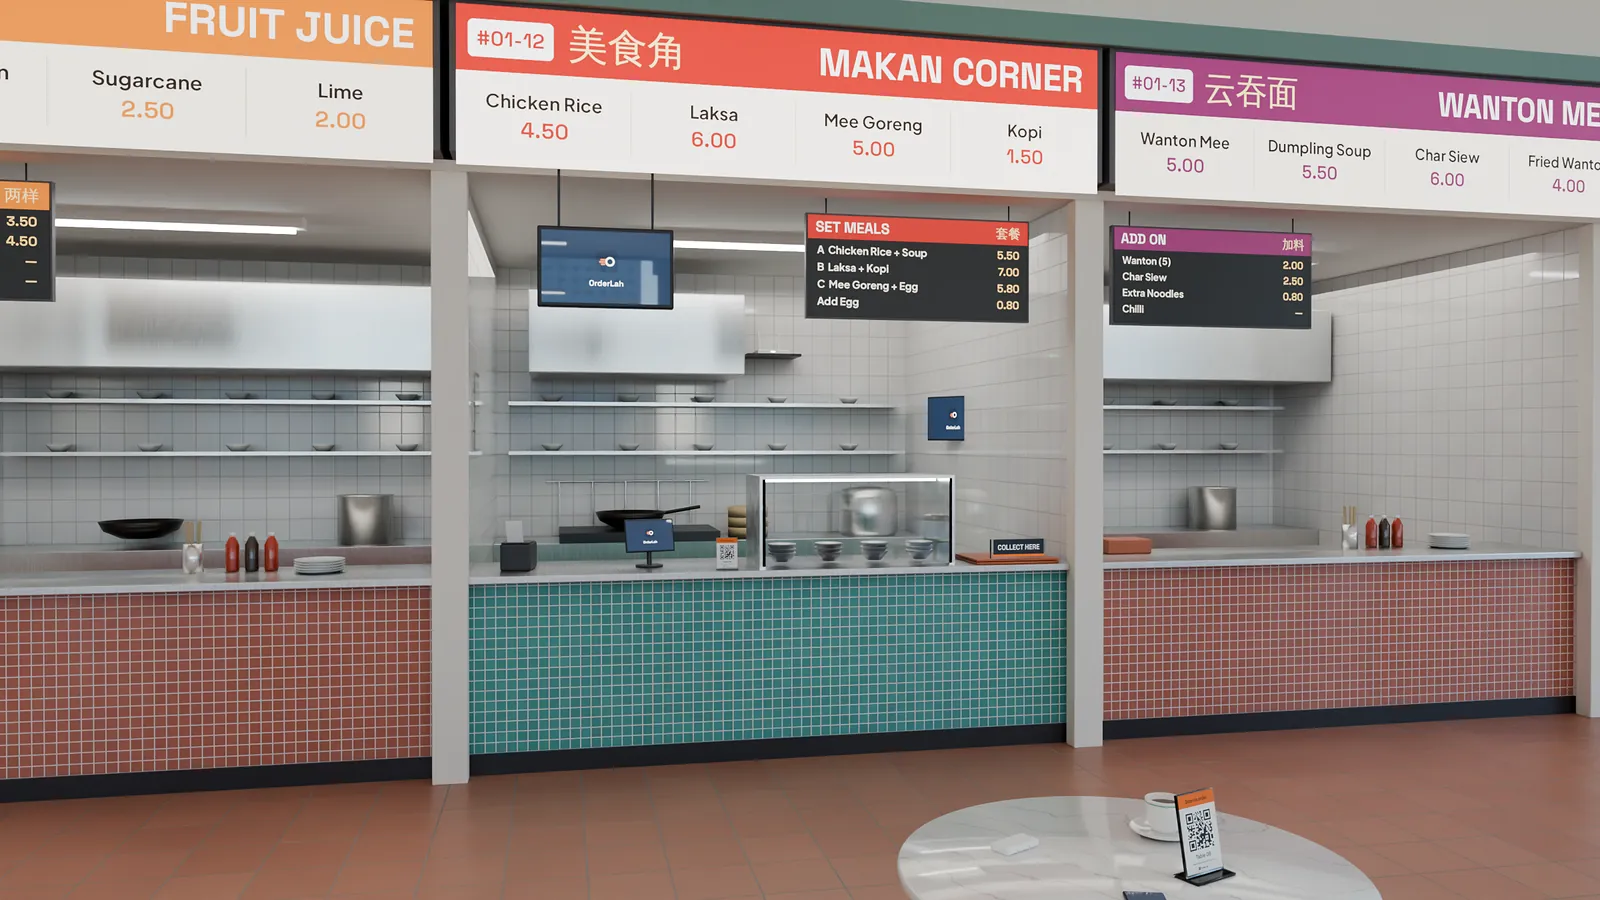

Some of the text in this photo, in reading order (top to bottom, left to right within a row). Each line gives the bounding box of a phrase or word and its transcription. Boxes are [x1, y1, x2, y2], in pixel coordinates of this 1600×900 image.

[165, 1, 414, 48] FRUIT JUICE
[477, 30, 544, 49] #01-12
[569, 25, 682, 70] 美食角
[820, 48, 1083, 93] MAKAN CORNER
[92, 70, 202, 91] Sugarcane
[1132, 76, 1186, 92] #01-13
[319, 83, 363, 100] Lime
[1204, 73, 1298, 110] 云吞面
[122, 101, 174, 120] 2.50
[486, 93, 602, 114] Chicken Rice
[1438, 91, 1600, 127] WANTON MEE
[315, 111, 366, 129] 2.00
[690, 105, 738, 122] Laksa
[521, 123, 569, 140] 4.50
[825, 113, 922, 135] Mee Goreng
[691, 132, 736, 149] 6.00
[1008, 124, 1042, 141] Kopi
[853, 141, 895, 157] 5.00
[1141, 132, 1230, 150] Wanton Mee
[1007, 149, 1043, 165] 1.50
[1268, 140, 1372, 160] Dumpling Soup
[1415, 149, 1480, 164] Char Siew
[1166, 158, 1204, 173] 5.00
[1529, 155, 1559, 168] Fried
[1302, 165, 1338, 181] 5.50
[1430, 172, 1464, 187] 6.00
[1552, 179, 1585, 193] 4.00
[4, 188, 39, 204] 两样
[6, 216, 38, 227] 3.50
[815, 221, 890, 235] SET MEALS
[6, 236, 38, 247] 4.50
[996, 227, 1021, 241] 套餐
[1121, 233, 1166, 245] ADD ON
[817, 245, 825, 254] A
[828, 246, 869, 255] Chicken
[870, 247, 892, 256] Rice
[901, 248, 928, 259] Soup
[997, 251, 1020, 260] 5.50
[1282, 238, 1304, 251] 加料
[817, 262, 825, 271] B
[828, 263, 857, 272] Laksa
[866, 264, 890, 275] Kopi
[998, 268, 1020, 277] 7.00
[1122, 256, 1304, 270] Wanton (5) 2.00
[588, 279, 625, 288] OrderLah
[817, 279, 825, 288] C
[829, 280, 850, 289] Mee
[852, 281, 890, 292] Goreng
[899, 282, 919, 293] Egg
[997, 284, 1020, 293] 5.80
[1122, 272, 1304, 286] Char Siew 2.50
[1122, 288, 1304, 301] Extra Noodles 0.80
[817, 297, 1020, 310] Add Egg 0.80
[1122, 304, 1145, 314] Chilli
